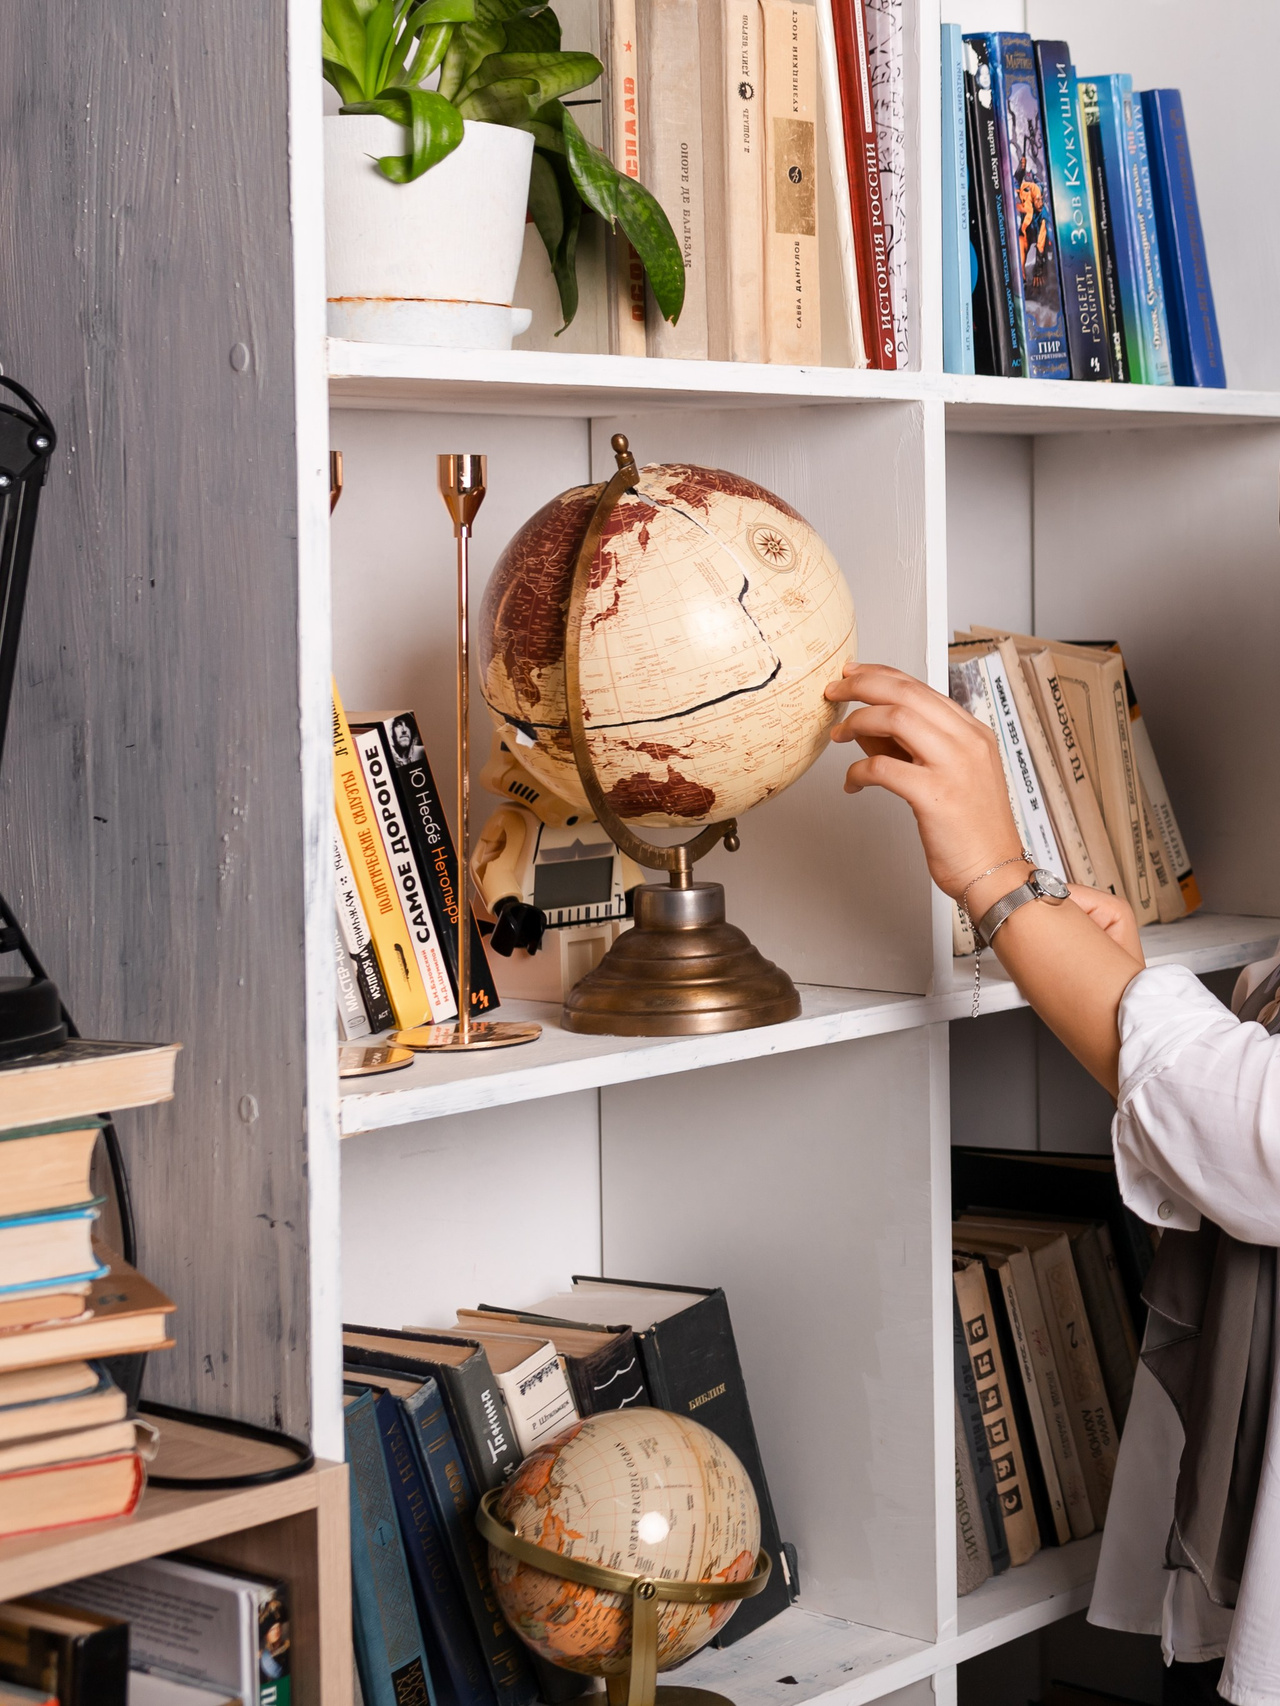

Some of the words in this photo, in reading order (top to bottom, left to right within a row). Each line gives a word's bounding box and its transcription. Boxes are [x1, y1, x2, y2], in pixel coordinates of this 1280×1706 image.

[791, 10, 799, 41] МОСТ
[792, 44, 800, 112] КУЗНЕЦКИЙ
[624, 76, 640, 178] СПЛАВ
[986, 120, 996, 153] Марта
[681, 142, 690, 180] ОНОРЕ
[959, 130, 967, 178] РАССКАЗЫ
[991, 156, 1000, 189] Кетро
[681, 186, 691, 204] ДЕ
[865, 143, 882, 227] РОССИИ
[960, 196, 968, 229] СКАЗКИ
[995, 194, 1008, 246] Улыбайся
[683, 209, 692, 268] БАЛЬЗАК
[794, 241, 802, 292] ДАНГУЛОВ
[875, 233, 892, 330] ИСТОРИЯ
[1075, 275, 1091, 334] РОБЕРТ
[1085, 263, 1100, 342] ГЭЛБРЕЙТ
[1038, 341, 1061, 353] ПИР
[994, 676, 1011, 717] КУМИРА
[1007, 721, 1020, 746] СЕБЕ
[409, 768, 426, 788] Ю
[1015, 748, 1035, 793] СОТВОРИ
[341, 770, 367, 825] СИЛУЭТЫ
[365, 745, 411, 854] ДОРОГОЕ
[416, 791, 442, 844] Несбё
[1029, 796, 1039, 811] НЕ
[356, 828, 393, 915] ПОЛИТИЧЕСКИЕ
[431, 846, 460, 924] Нетопырь
[399, 861, 432, 944] САМОЕ
[688, 1383, 727, 1412] БИБЛИЯ
[386, 1420, 417, 1482] НЕБА
[614, 1441, 635, 1469] OCEAN
[628, 1471, 642, 1515] PACIFIC
[406, 1485, 448, 1596] СОЛДАТЫ
[627, 1520, 640, 1558] NORTH
